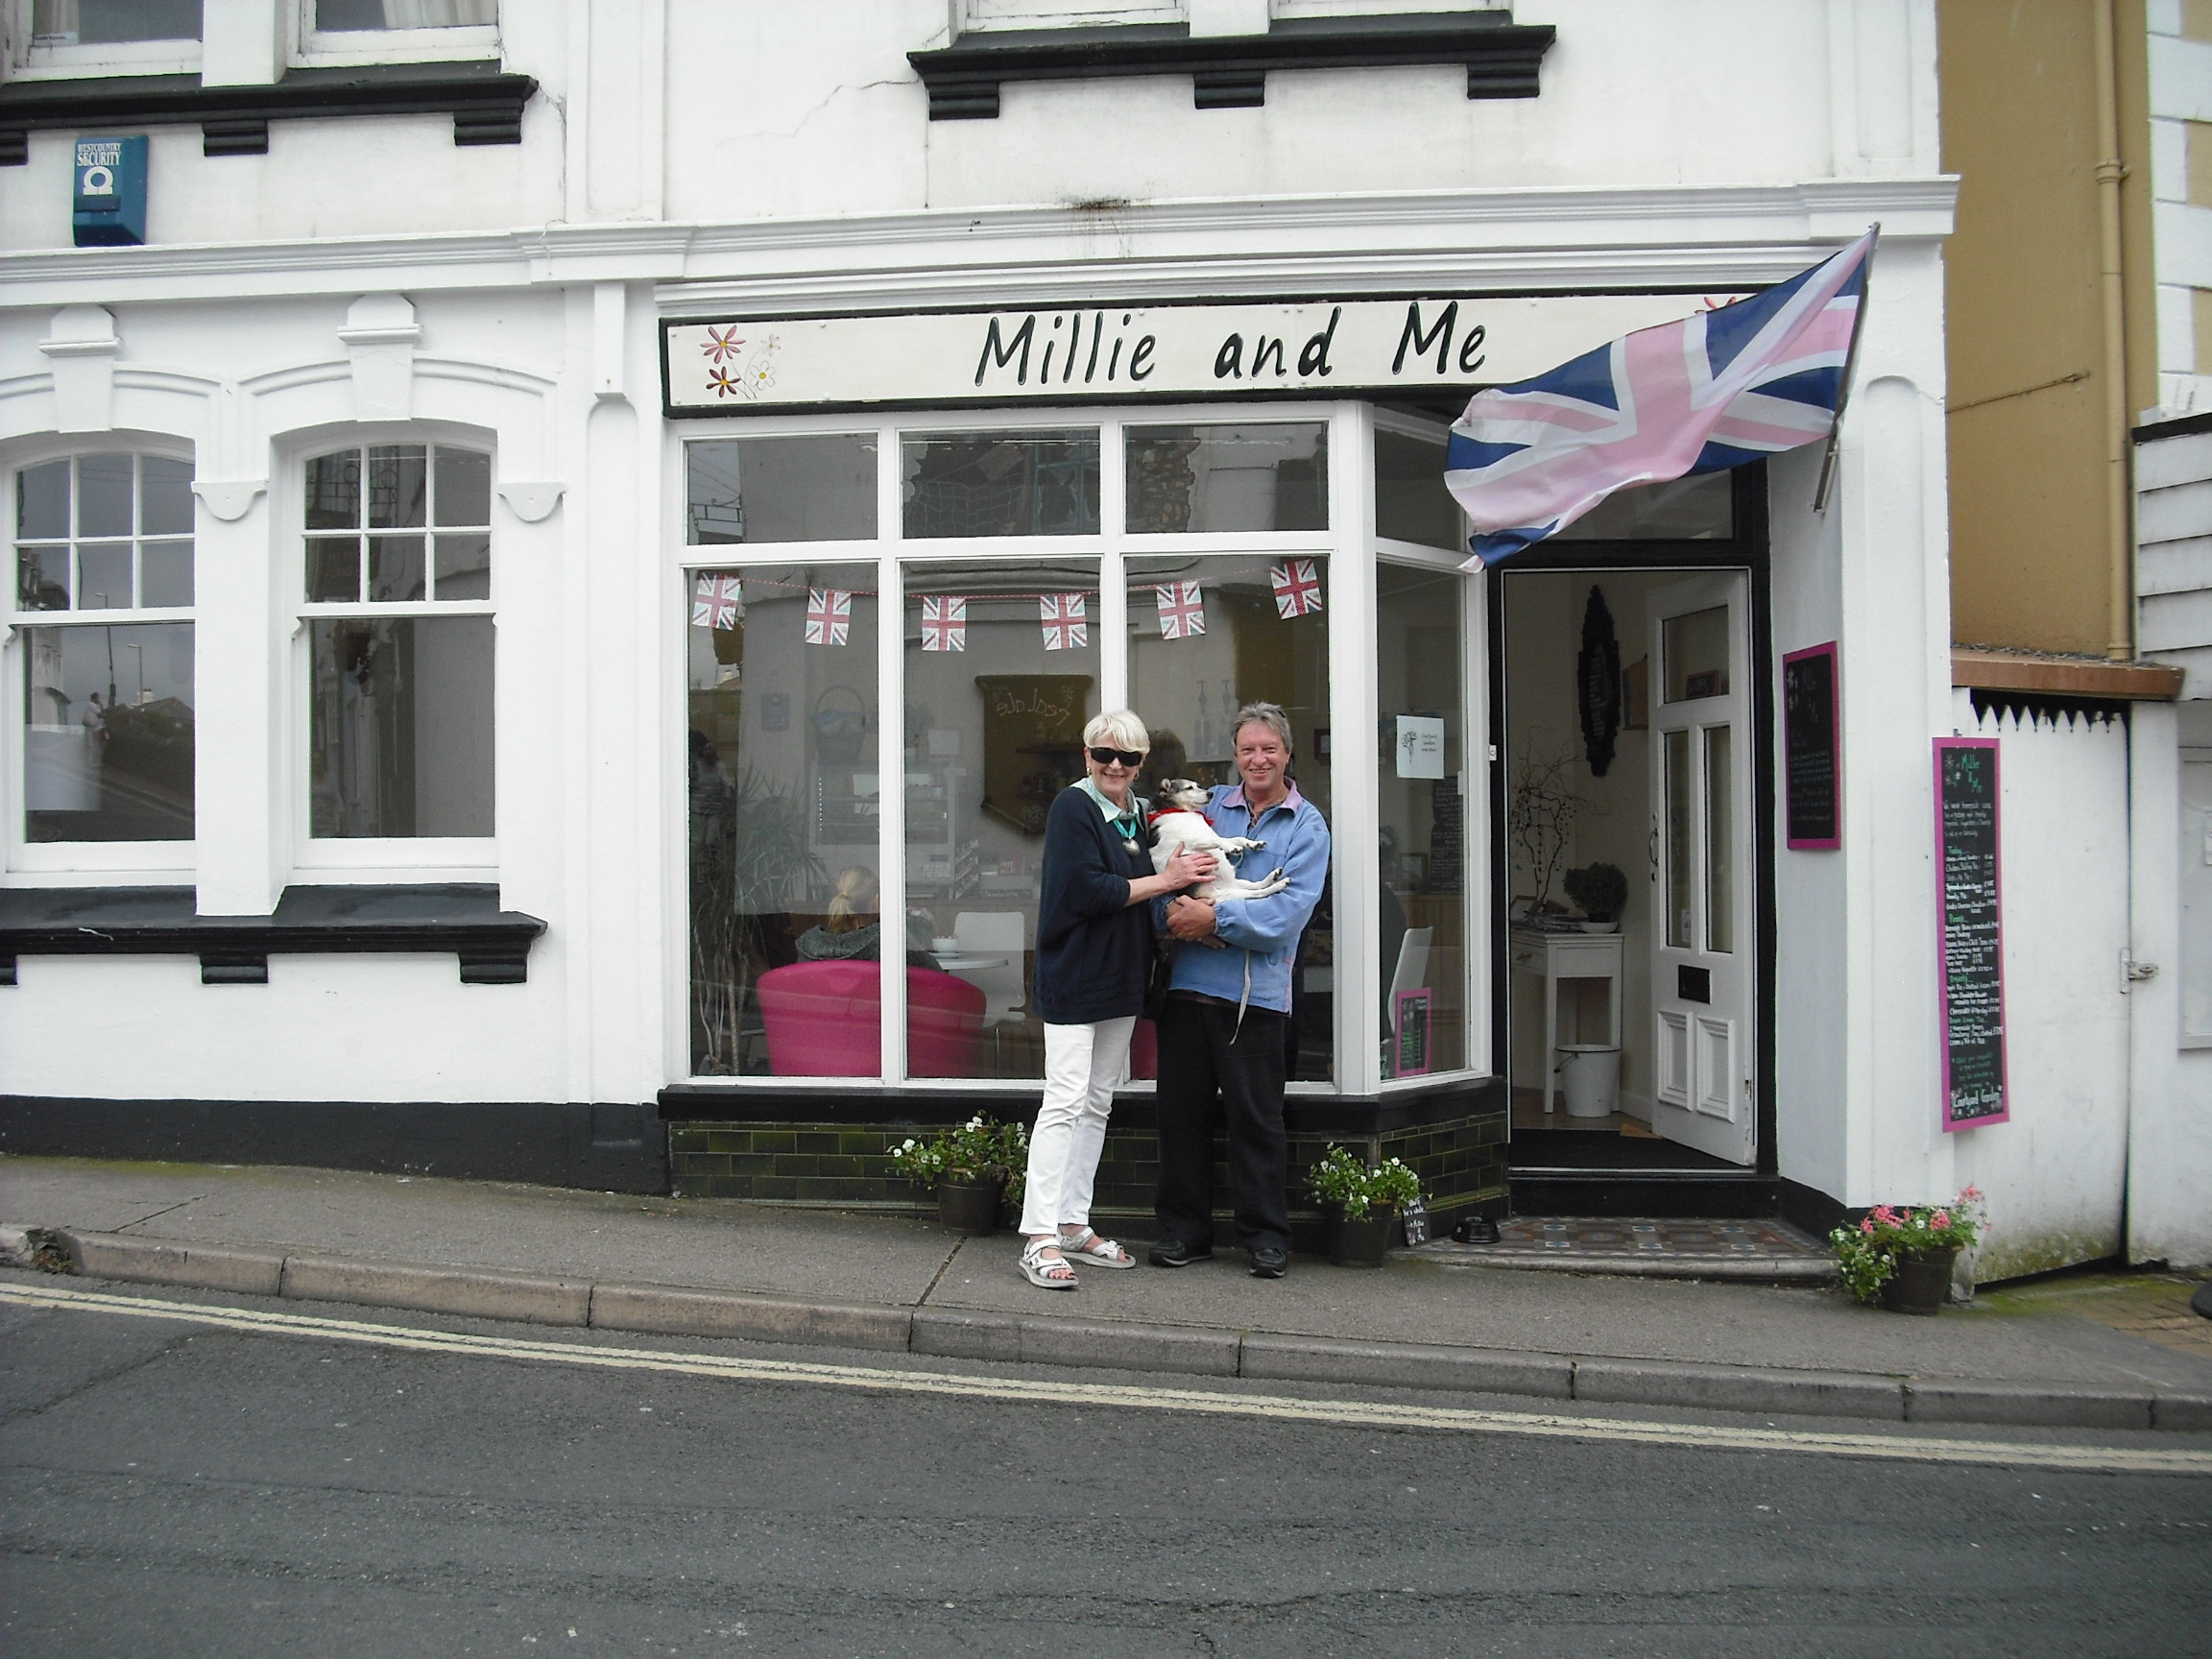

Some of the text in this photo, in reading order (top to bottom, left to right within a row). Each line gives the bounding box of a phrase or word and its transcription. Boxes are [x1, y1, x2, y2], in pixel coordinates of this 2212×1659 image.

[77, 152, 121, 166] SECURITY
[974, 301, 1486, 386] Millie and Me
